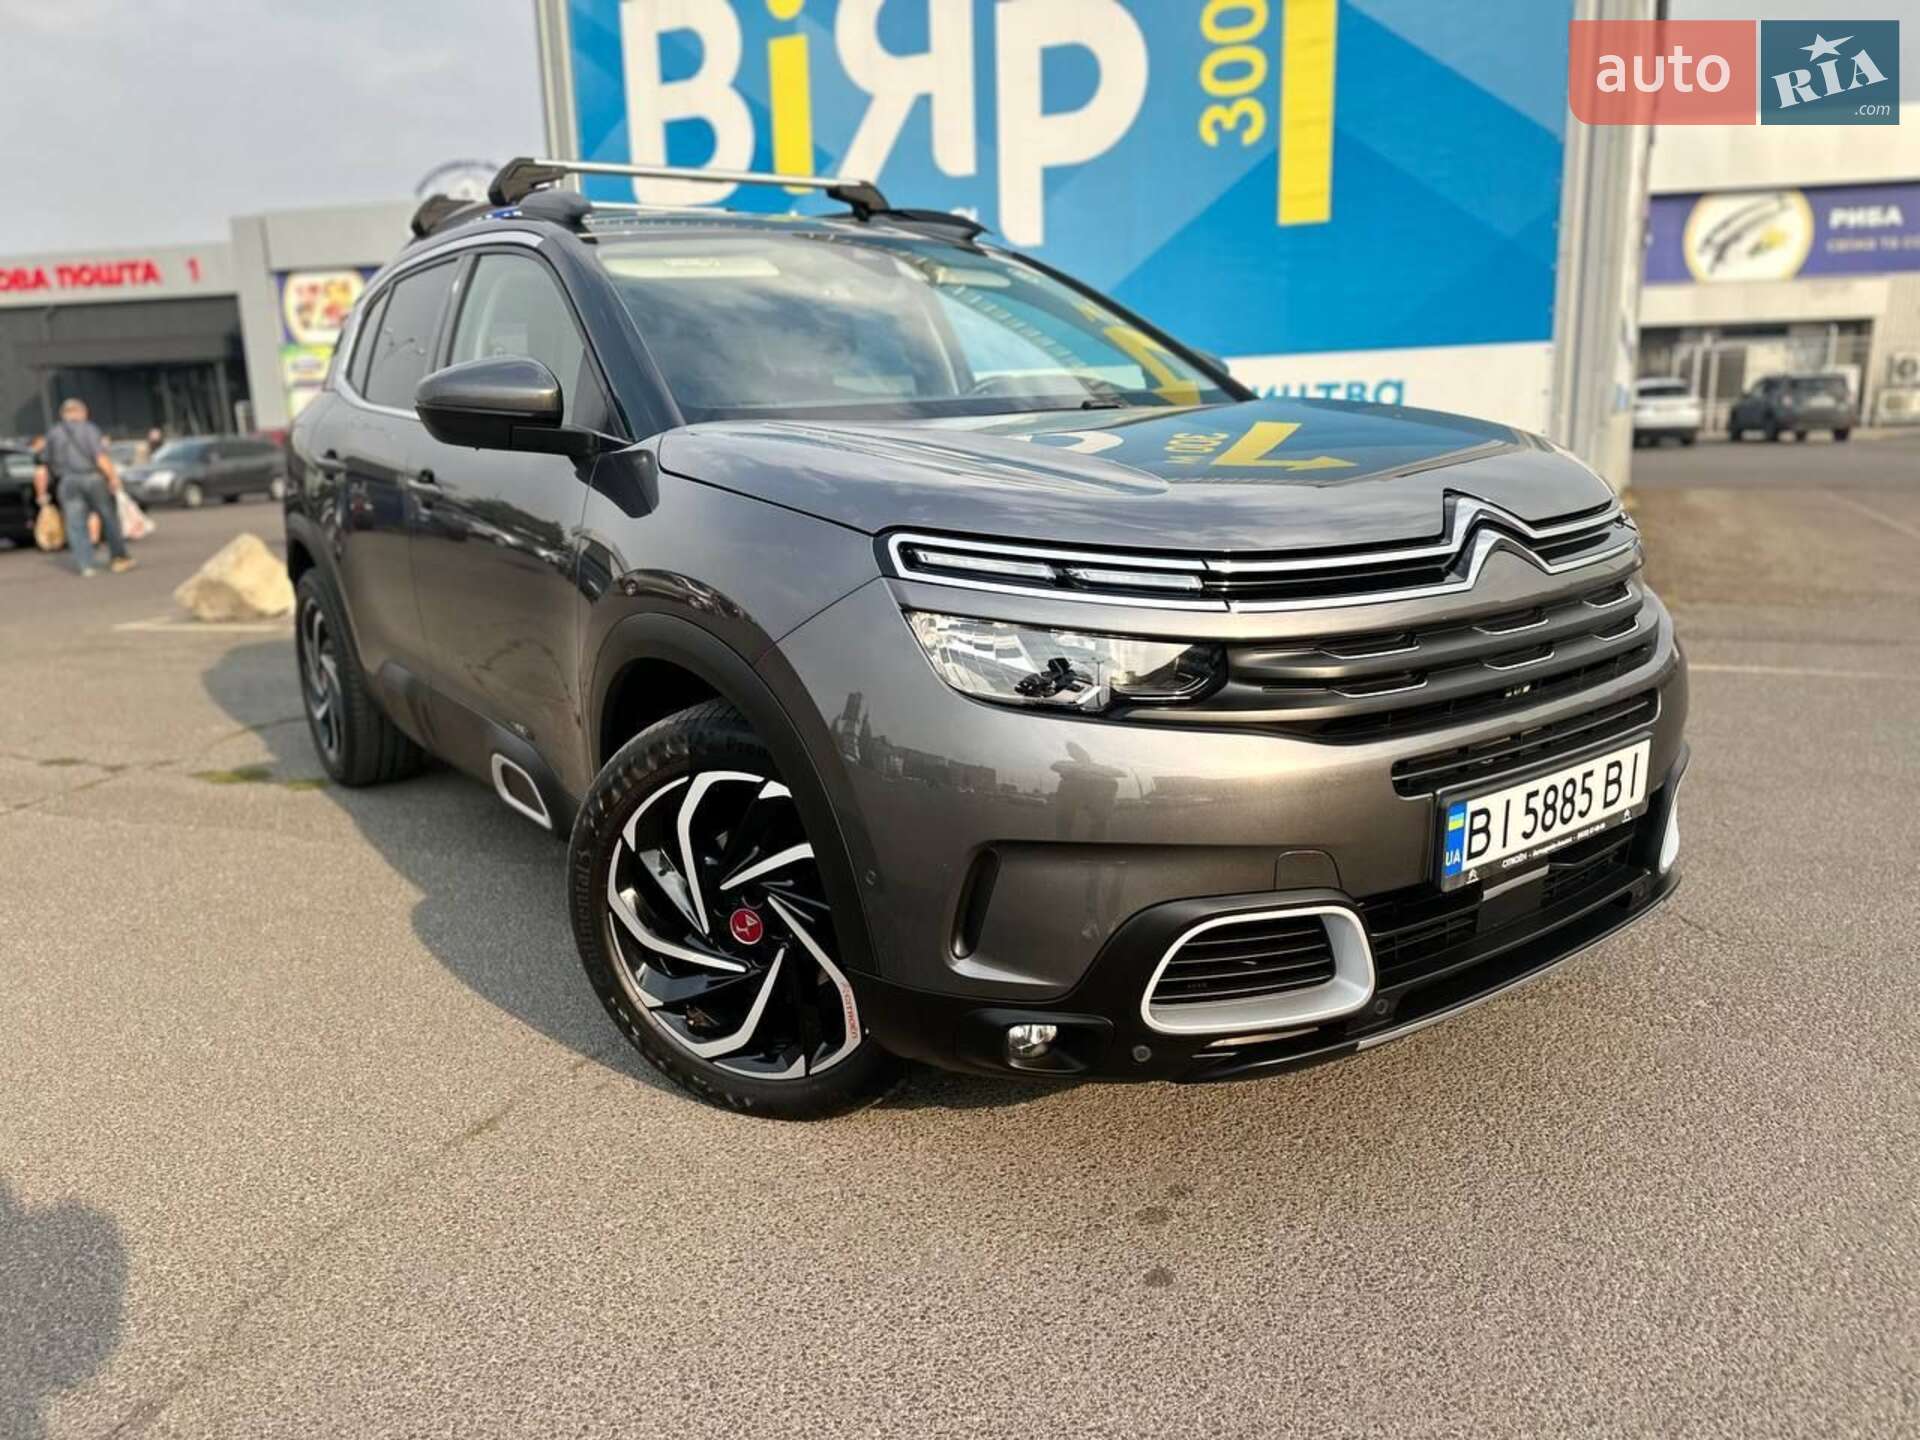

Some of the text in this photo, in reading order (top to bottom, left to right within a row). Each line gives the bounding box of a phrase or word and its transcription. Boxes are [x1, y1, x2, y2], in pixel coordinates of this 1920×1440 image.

[1200, 0, 1268, 147] 300
[56, 260, 162, 287] ПОШТА
[1467, 752, 1639, 861] BI 5885 BI
[1445, 850, 1461, 866] UA
